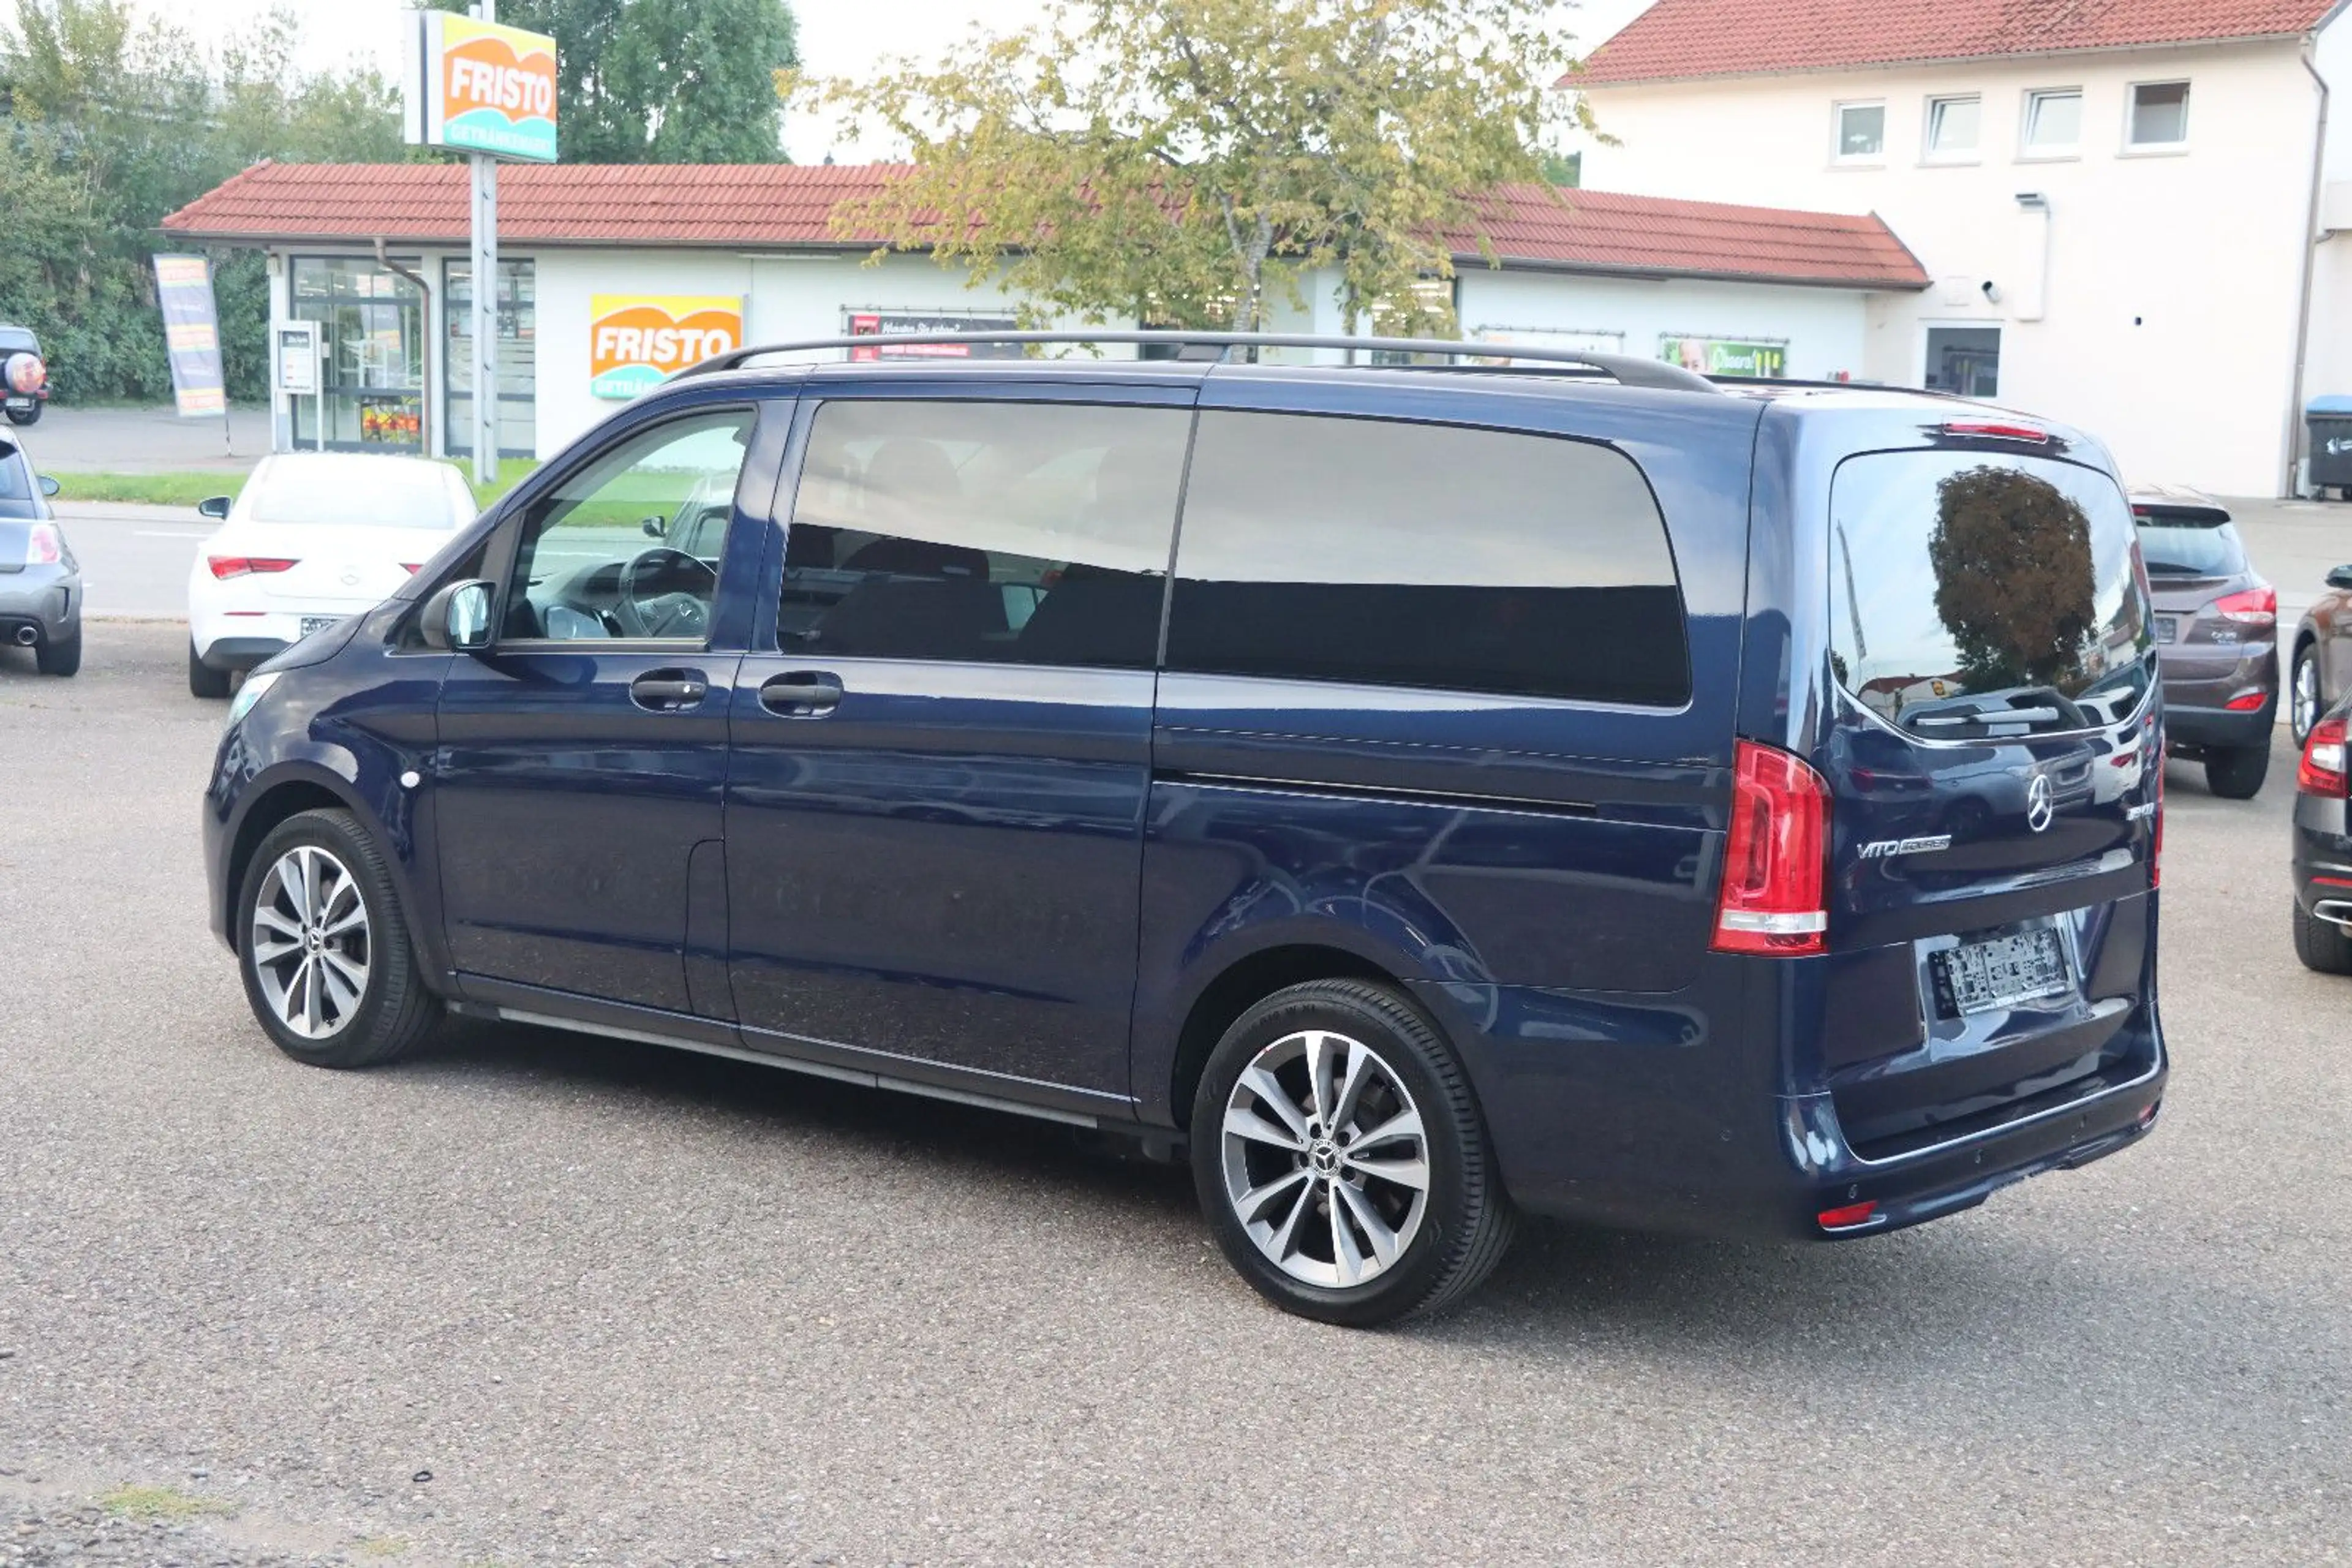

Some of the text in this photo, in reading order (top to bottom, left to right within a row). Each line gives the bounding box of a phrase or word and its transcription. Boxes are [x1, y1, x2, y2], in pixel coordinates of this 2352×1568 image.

[450, 57, 552, 114] FRISTO
[595, 327, 733, 363] FRISTO
[1856, 840, 1899, 859] VITO
